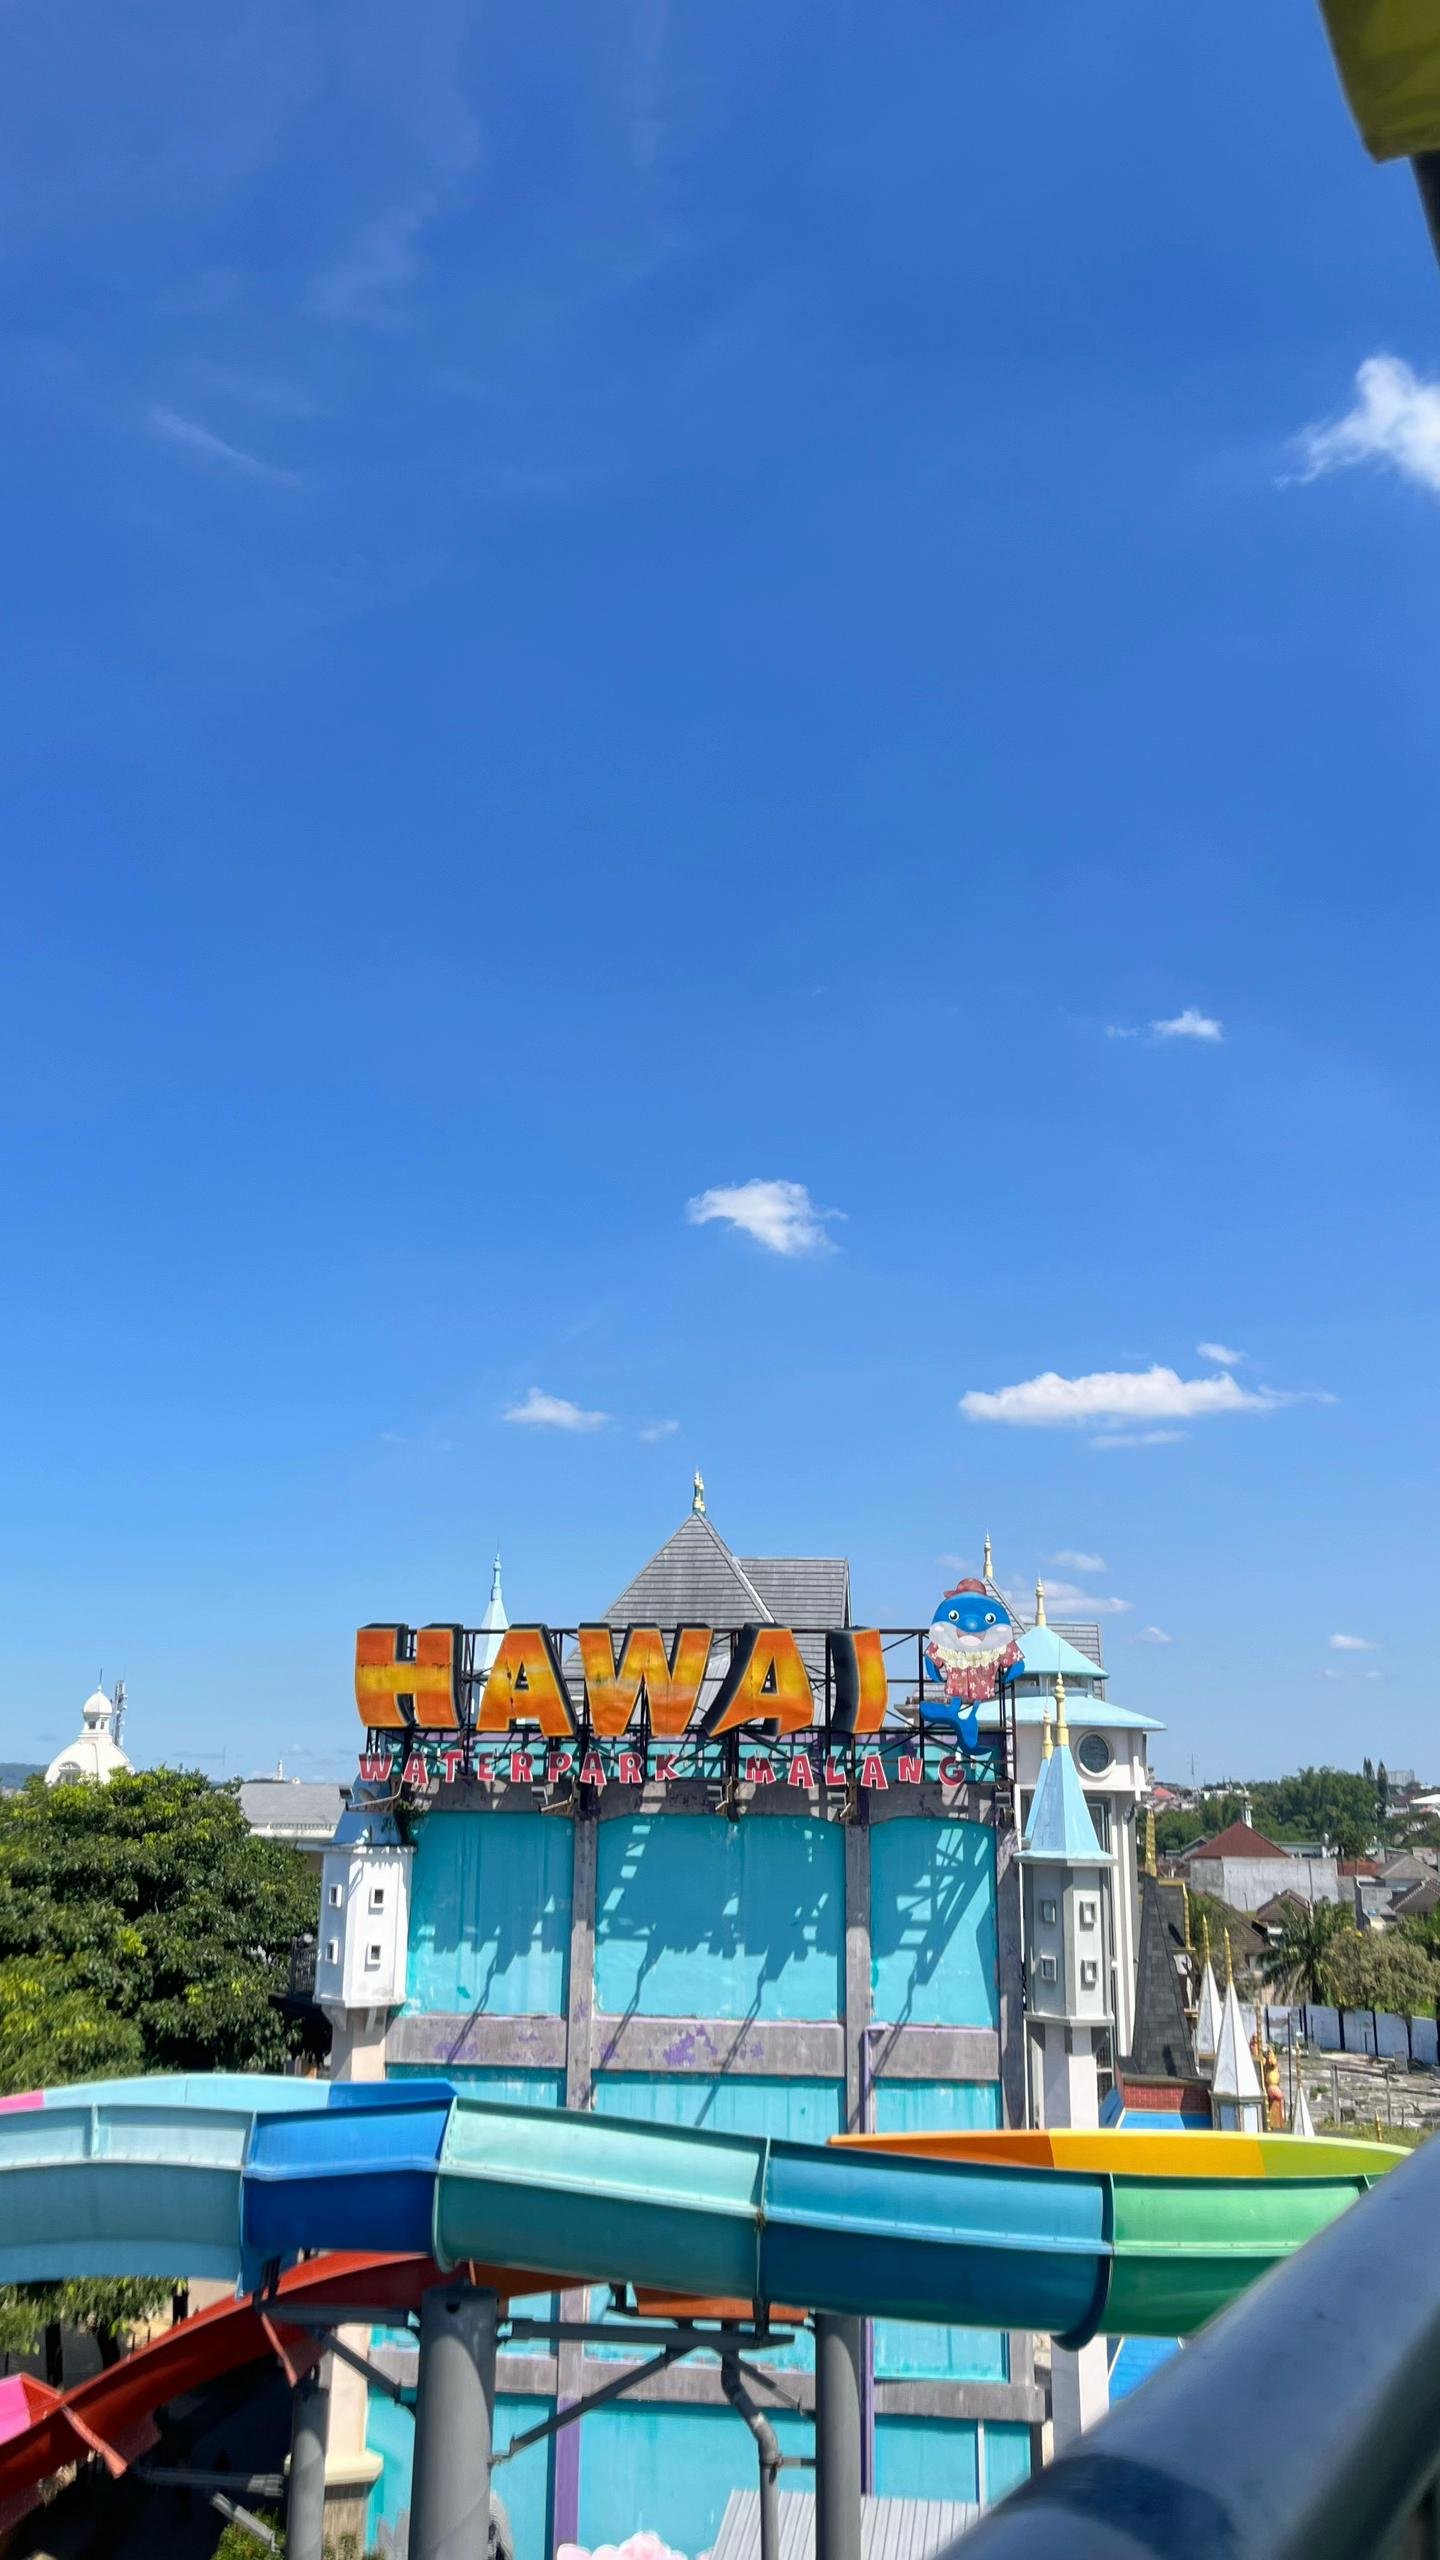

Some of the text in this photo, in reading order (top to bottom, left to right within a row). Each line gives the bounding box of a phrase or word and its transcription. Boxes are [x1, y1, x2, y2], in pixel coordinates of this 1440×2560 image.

[356, 1624, 888, 1737] HAWAI
[358, 1750, 966, 1789] WATERPARK MALANG
